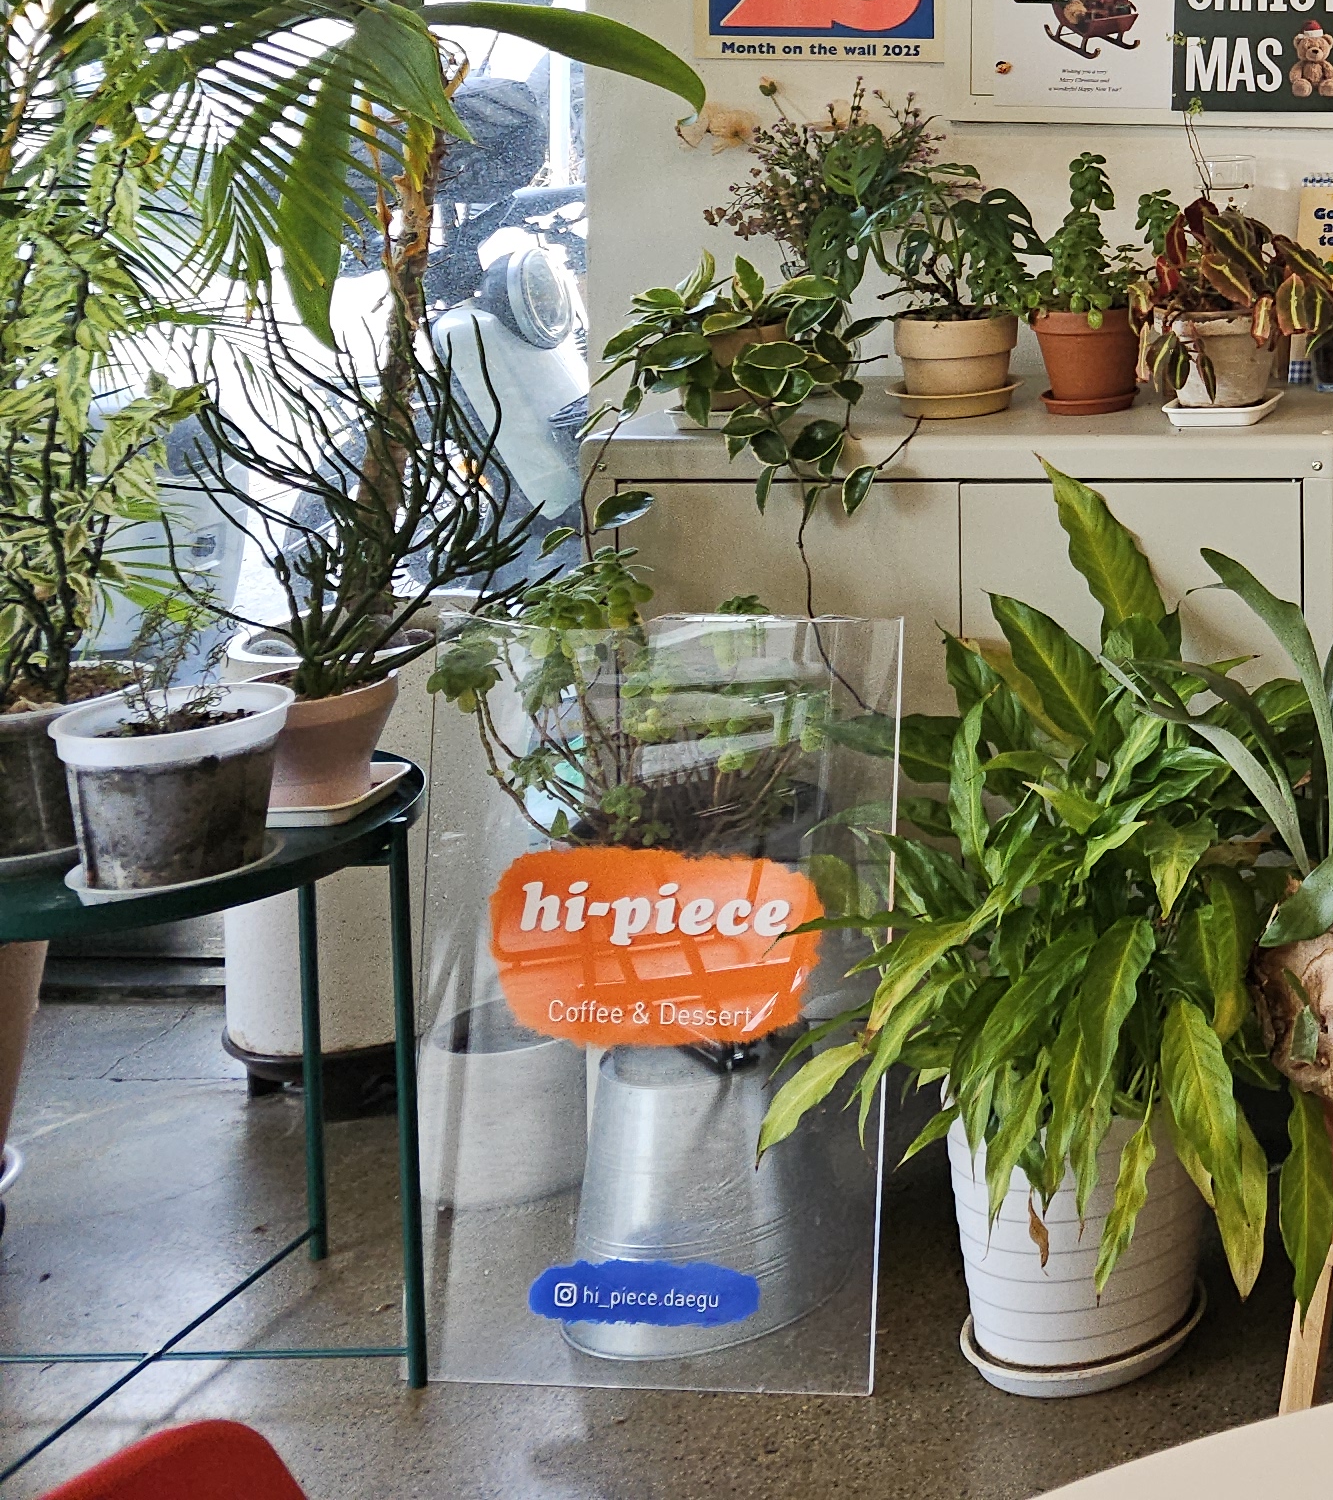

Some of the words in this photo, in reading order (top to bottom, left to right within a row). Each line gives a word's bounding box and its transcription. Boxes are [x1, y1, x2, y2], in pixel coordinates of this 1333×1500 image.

[720, 41, 776, 55] Month
[782, 44, 803, 55] on
[809, 43, 838, 56] the
[843, 43, 877, 57] wall
[882, 44, 921, 57] 2025
[1185, 36, 1283, 93] MAS
[519, 880, 792, 947] hi-piece
[546, 999, 624, 1026] Coffee
[632, 1000, 651, 1026] &
[658, 1000, 754, 1028] Dessert
[580, 1284, 721, 1312] hi_piece.daegu
